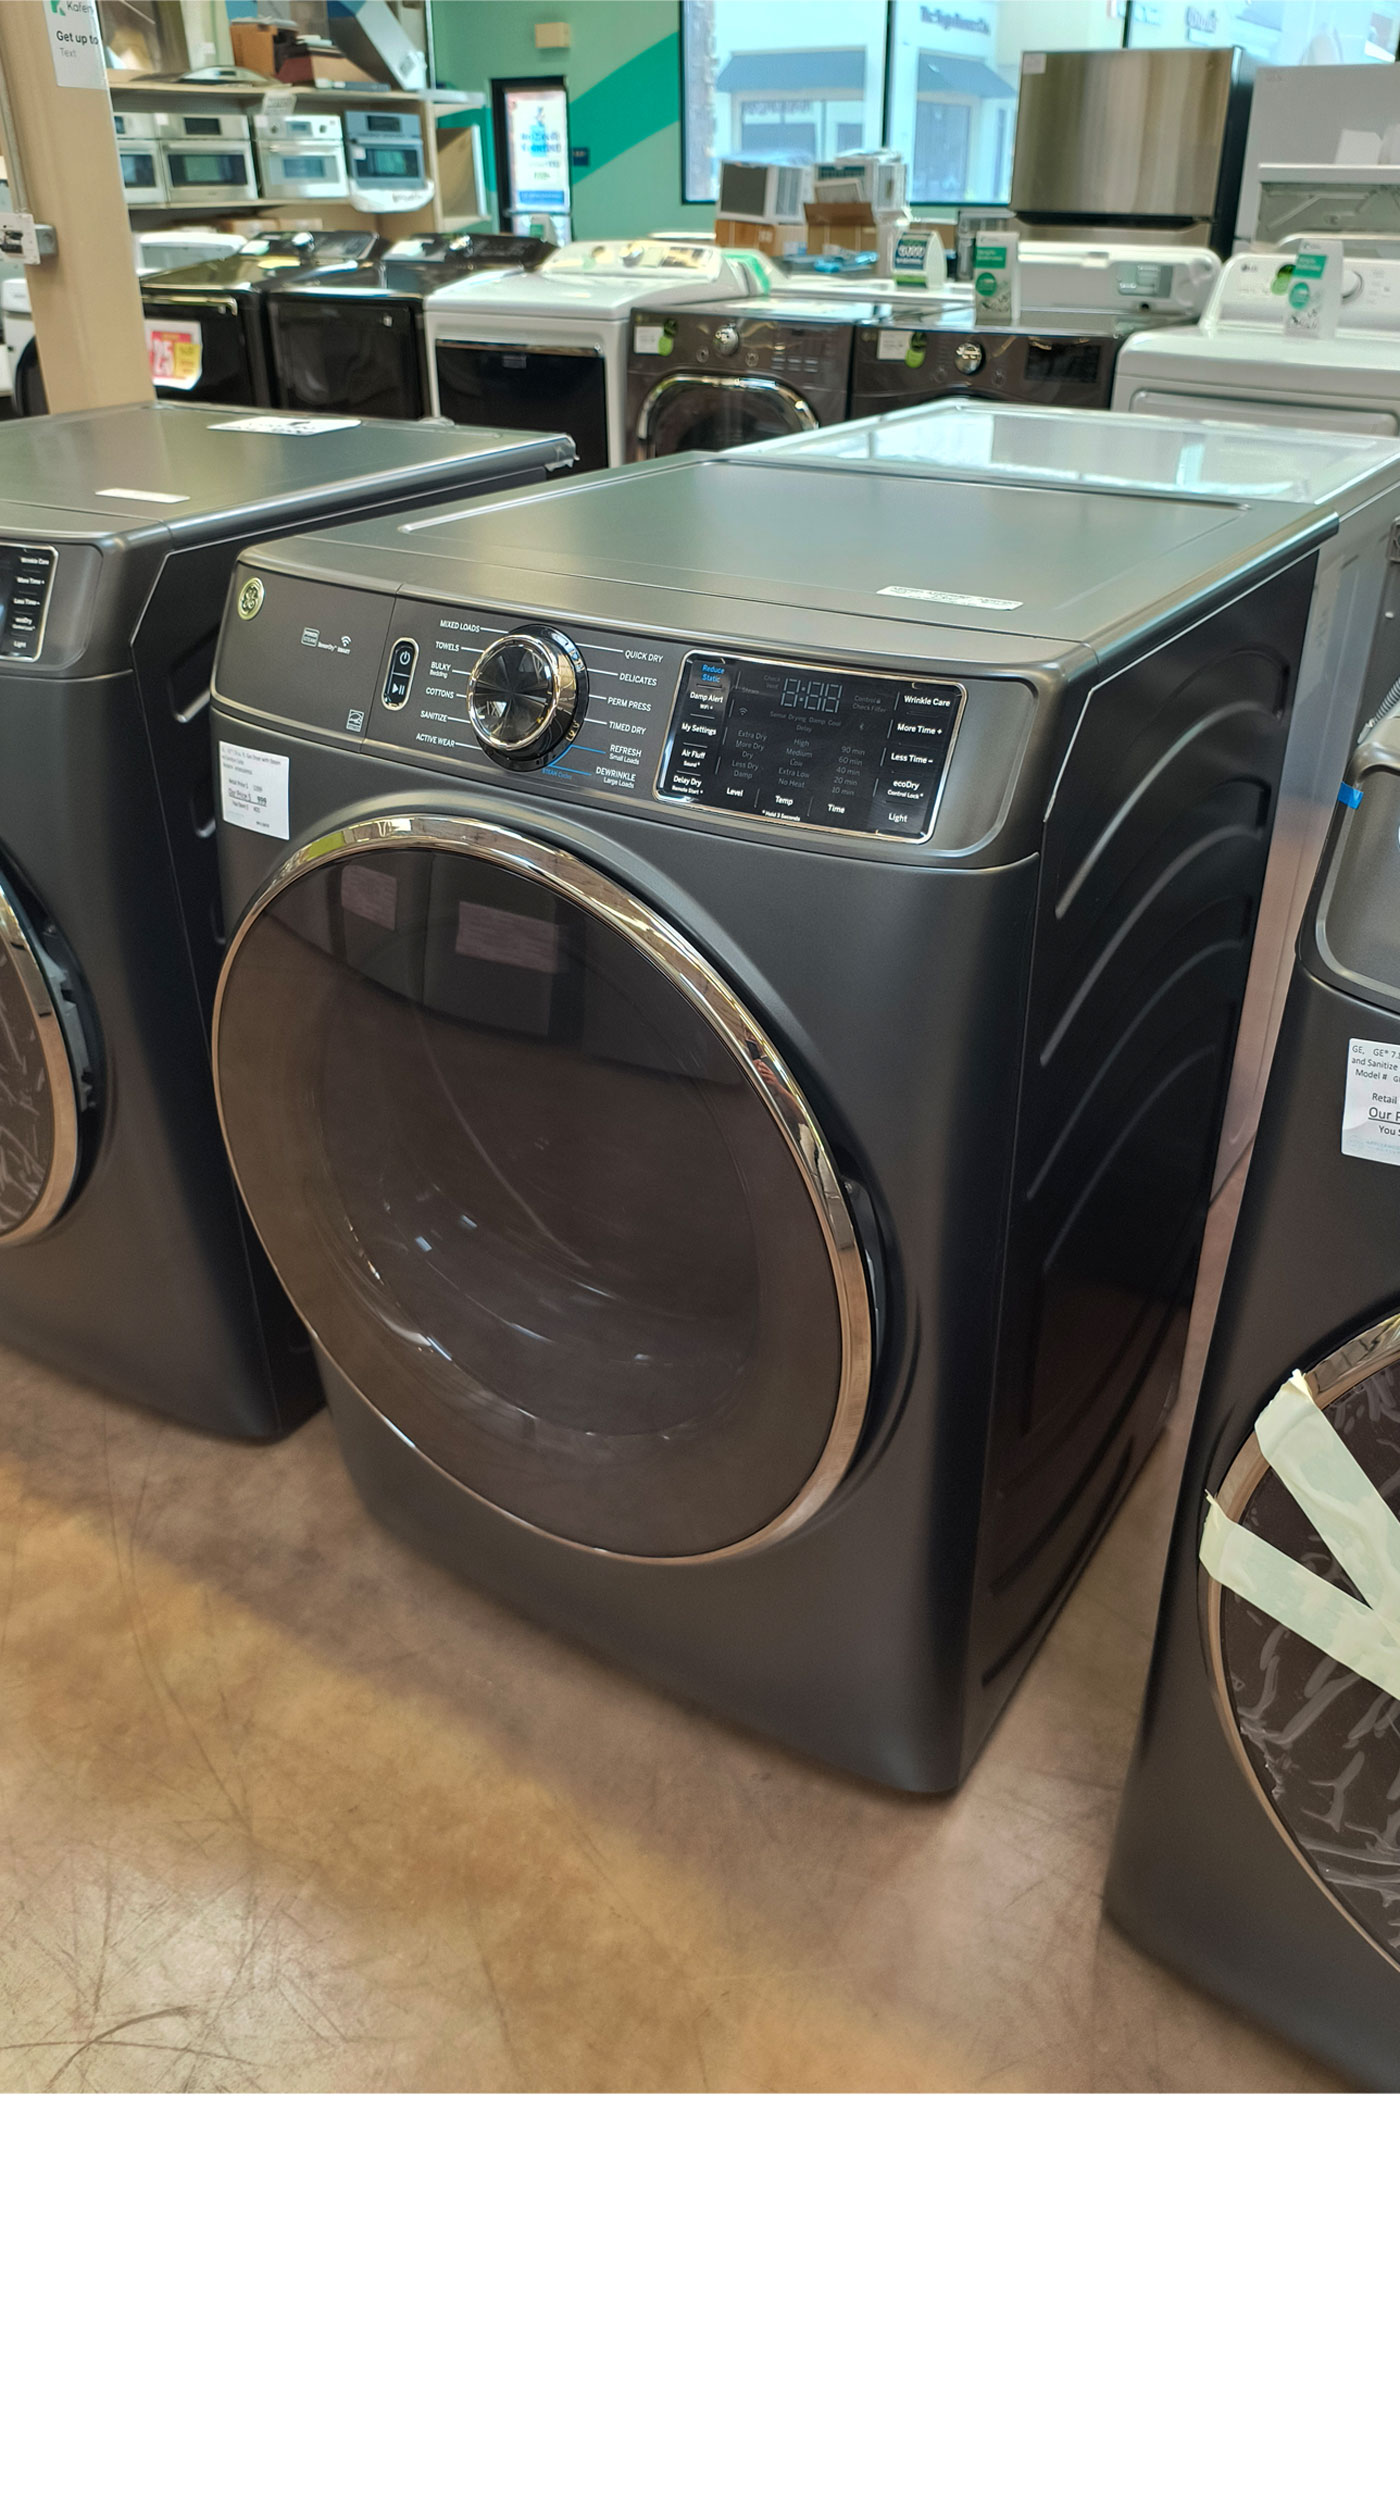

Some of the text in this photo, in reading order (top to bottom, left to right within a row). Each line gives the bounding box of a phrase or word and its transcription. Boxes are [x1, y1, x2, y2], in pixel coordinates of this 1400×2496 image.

[56, 30, 99, 46] Get up to
[440, 620, 480, 633] MIXED LOADS
[436, 641, 460, 652] TOWELS
[624, 650, 664, 663] QUICK DRY
[431, 662, 452, 672] BULKY
[702, 664, 725, 674] Reduce
[620, 672, 658, 686] DELICATES
[702, 673, 720, 683] Static
[426, 686, 454, 699] COTTONS
[690, 691, 724, 703] Damp Alert
[608, 696, 652, 712] PERM PRESS
[904, 696, 950, 707] Wrinkle Care
[420, 710, 448, 722] SANITIZE
[608, 720, 647, 735] TIMED DRY
[681, 722, 717, 736] My Settings
[897, 722, 916, 732] More
[918, 725, 936, 735] Time
[416, 733, 456, 748] ACTIVE WEAR
[738, 730, 768, 742] Extra Dry
[736, 740, 764, 752] More Dry
[794, 738, 810, 748] High
[610, 744, 642, 758] REFRESH
[681, 748, 691, 758] Air
[742, 751, 754, 760] Dry
[786, 748, 813, 758] Medium
[841, 746, 851, 754] 90
[609, 753, 640, 765] Small Loads
[838, 756, 848, 764] 60
[890, 752, 908, 762] Less
[908, 754, 928, 764] Time
[732, 760, 758, 771] Less Dry
[836, 766, 846, 774] 40
[596, 766, 636, 782] DEWRINKLE
[734, 770, 752, 780] Damp
[778, 768, 810, 778] Extra Low
[604, 777, 634, 789] Large Loads
[673, 775, 702, 788] Delay Dry
[778, 778, 805, 788] No Heat
[833, 776, 844, 784] 20
[892, 780, 920, 791] ecoDry
[726, 787, 744, 797] Level
[832, 786, 840, 794] 10
[888, 789, 907, 798] Control
[775, 795, 794, 806] Temp
[828, 804, 846, 814] Time
[888, 812, 908, 823] Light
[1352, 1058, 1398, 1071] and Sanitize
[1355, 1068, 1380, 1080] Model
[1372, 1092, 1398, 1104] Retail
[1368, 1106, 1392, 1120] Our
[1378, 1124, 1396, 1136] You
